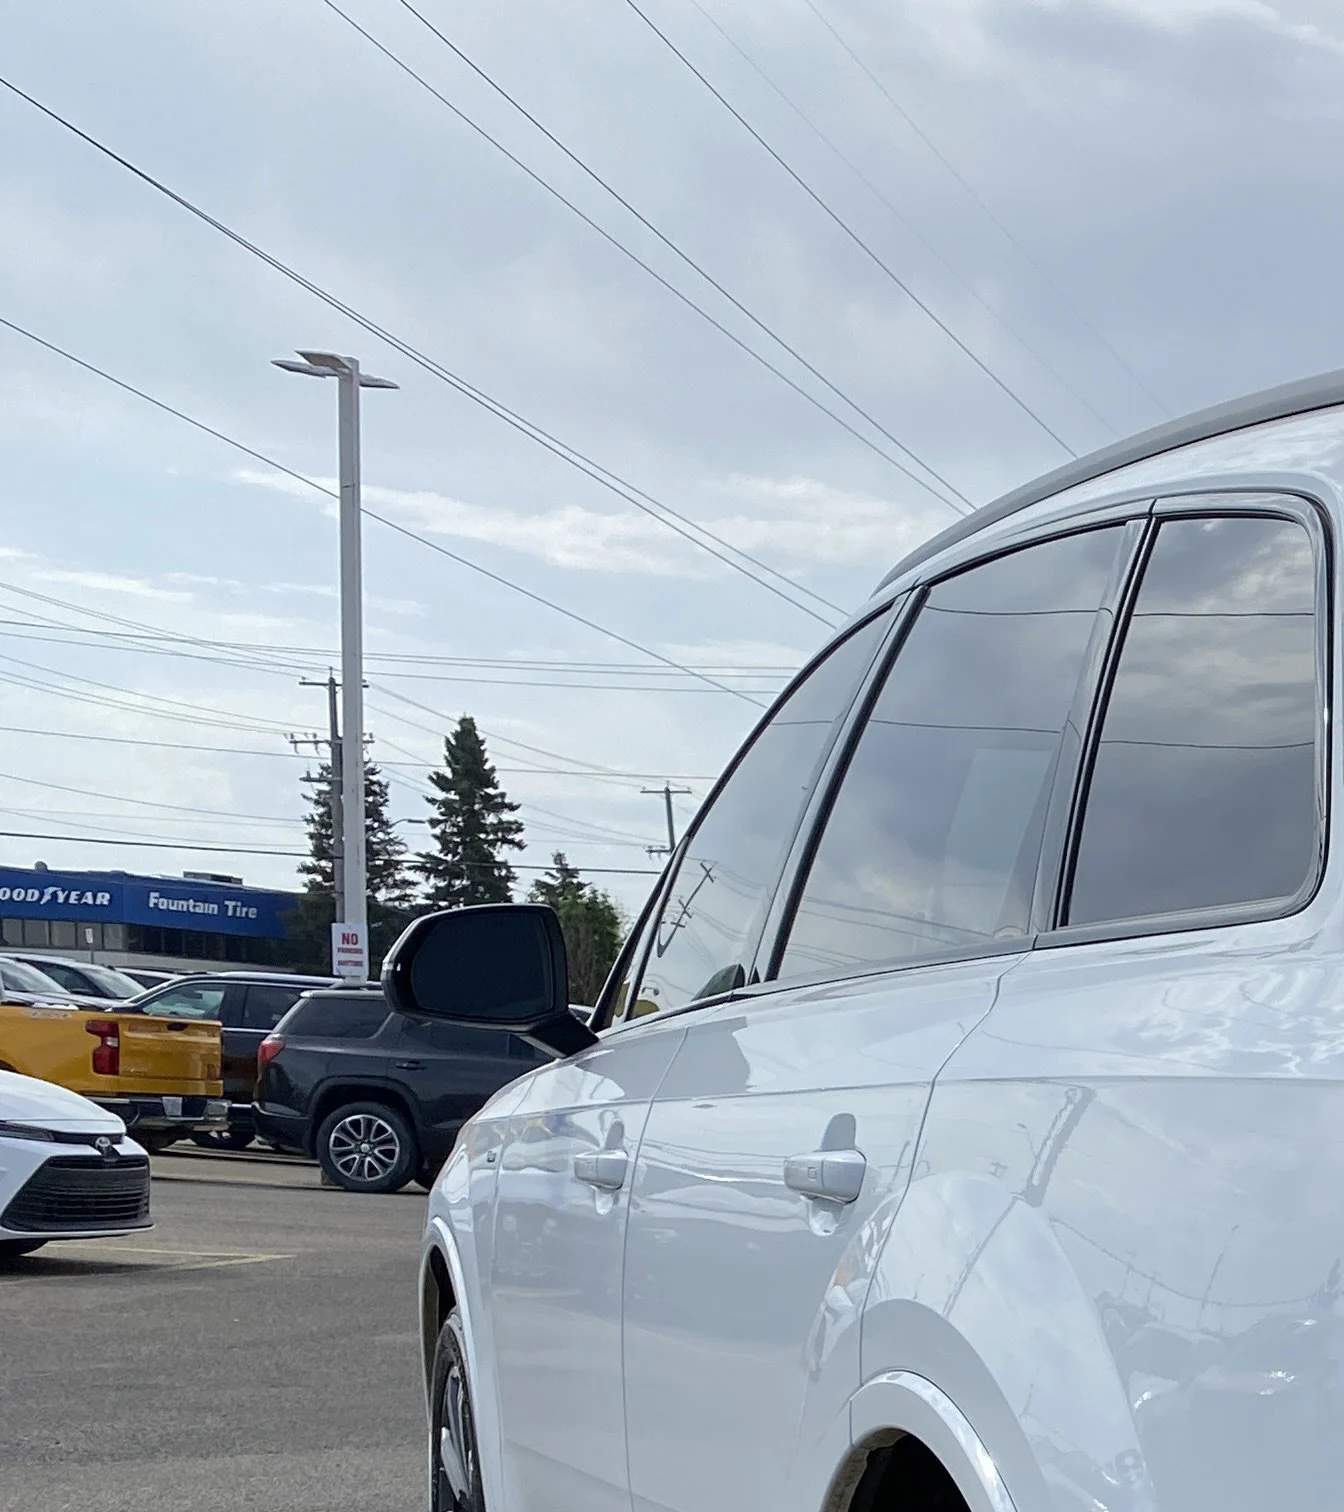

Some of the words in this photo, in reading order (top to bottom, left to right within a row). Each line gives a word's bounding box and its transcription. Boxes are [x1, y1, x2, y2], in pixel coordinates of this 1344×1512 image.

[148, 891, 219, 915] Fountain
[224, 900, 258, 919] Tire
[341, 932, 359, 946] NO
